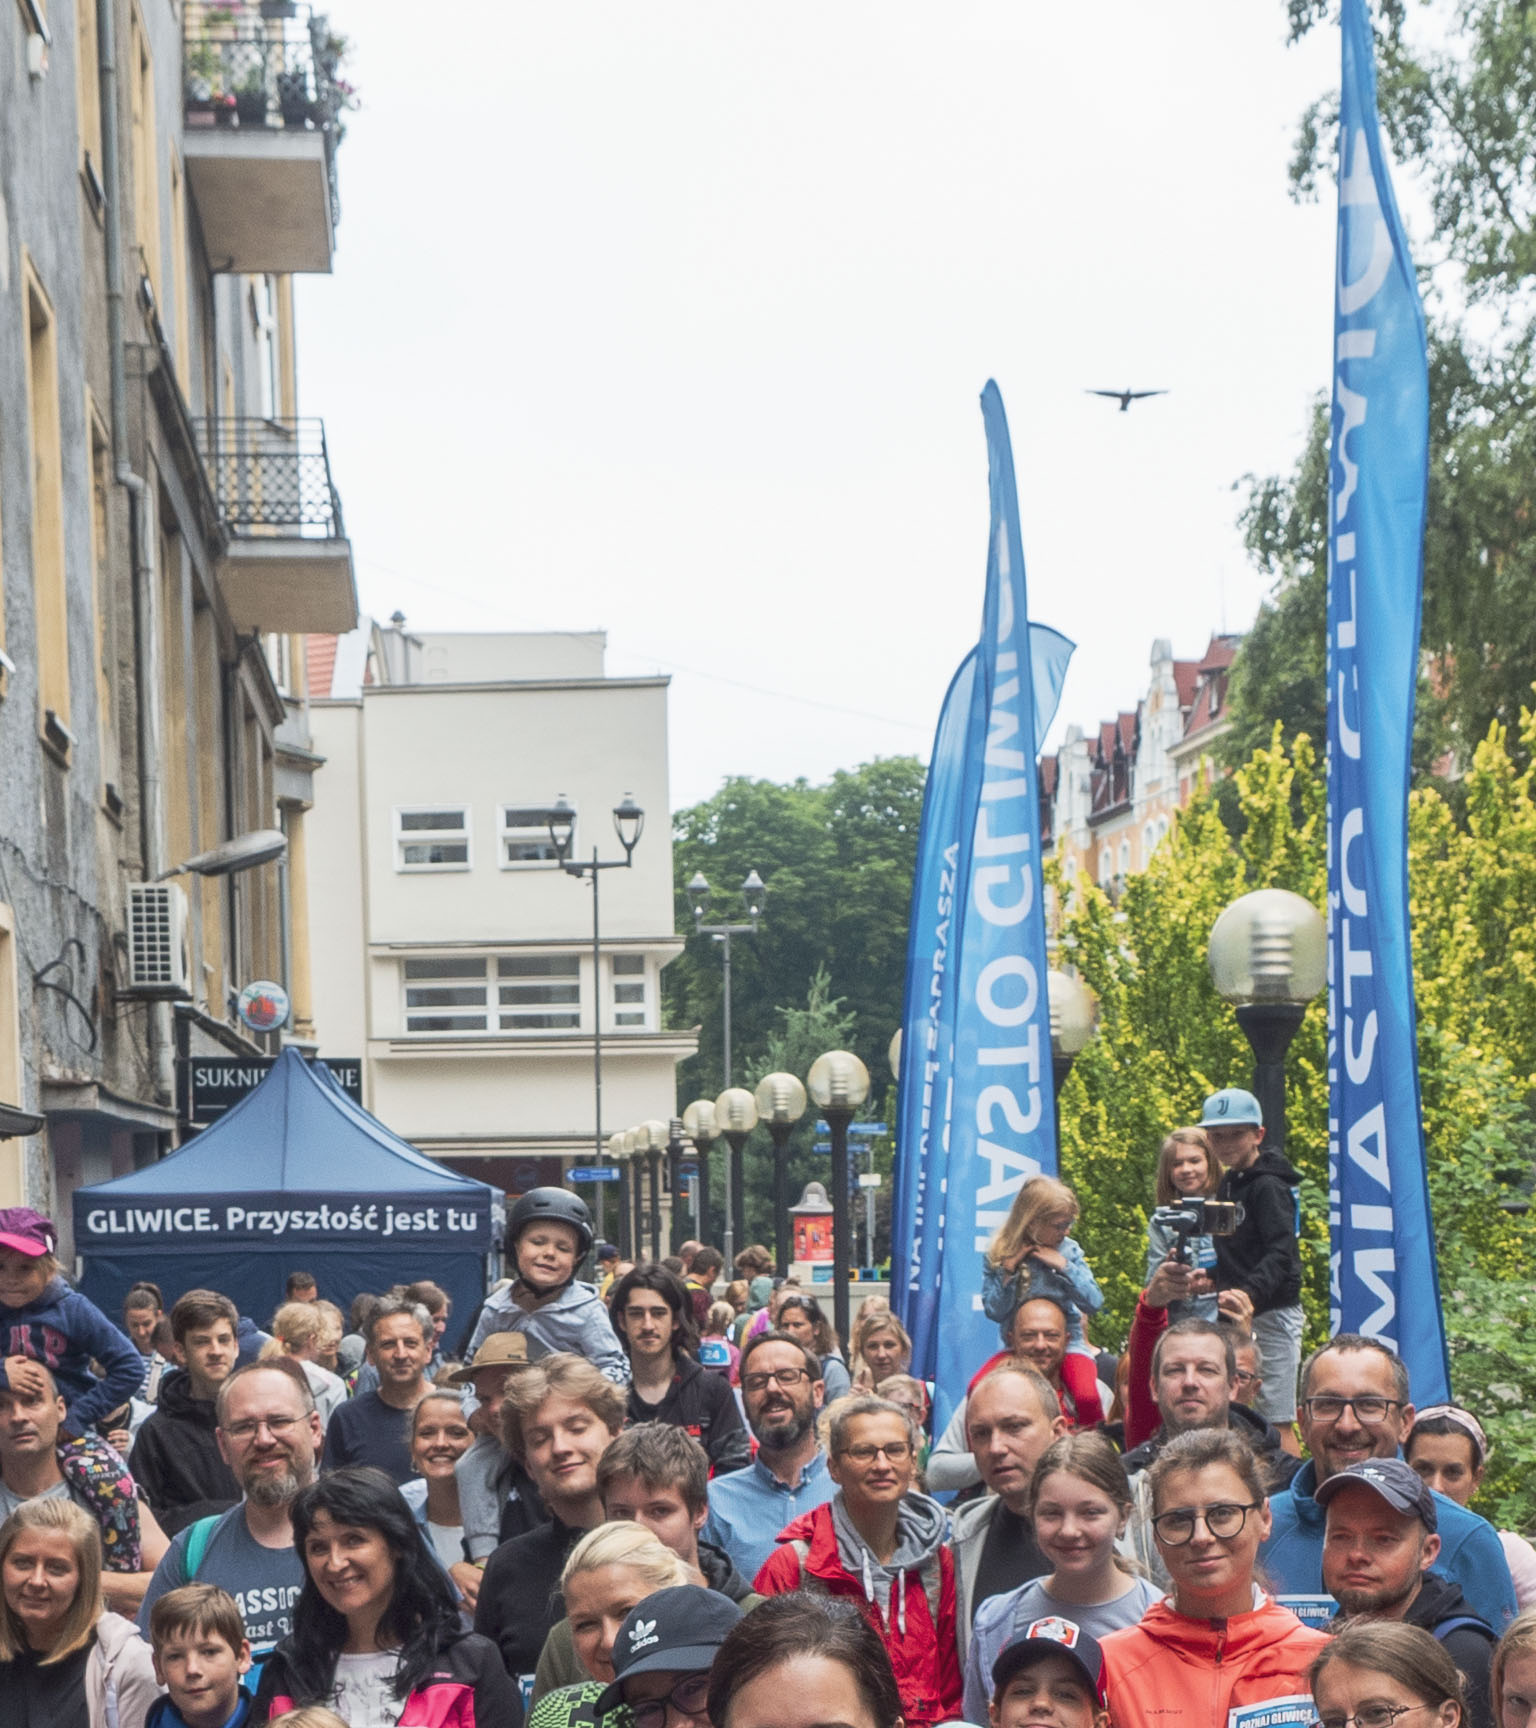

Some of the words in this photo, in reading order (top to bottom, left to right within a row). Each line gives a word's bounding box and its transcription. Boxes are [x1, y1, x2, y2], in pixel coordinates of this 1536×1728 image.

[87, 1208, 219, 1233] GLIWICE.
[227, 1204, 377, 1235] Przyszłość
[382, 1205, 440, 1236] jest
[447, 1208, 477, 1231] tu
[235, 1585, 302, 1617] ASSIC
[1271, 1708, 1313, 1726] GLIWICE
